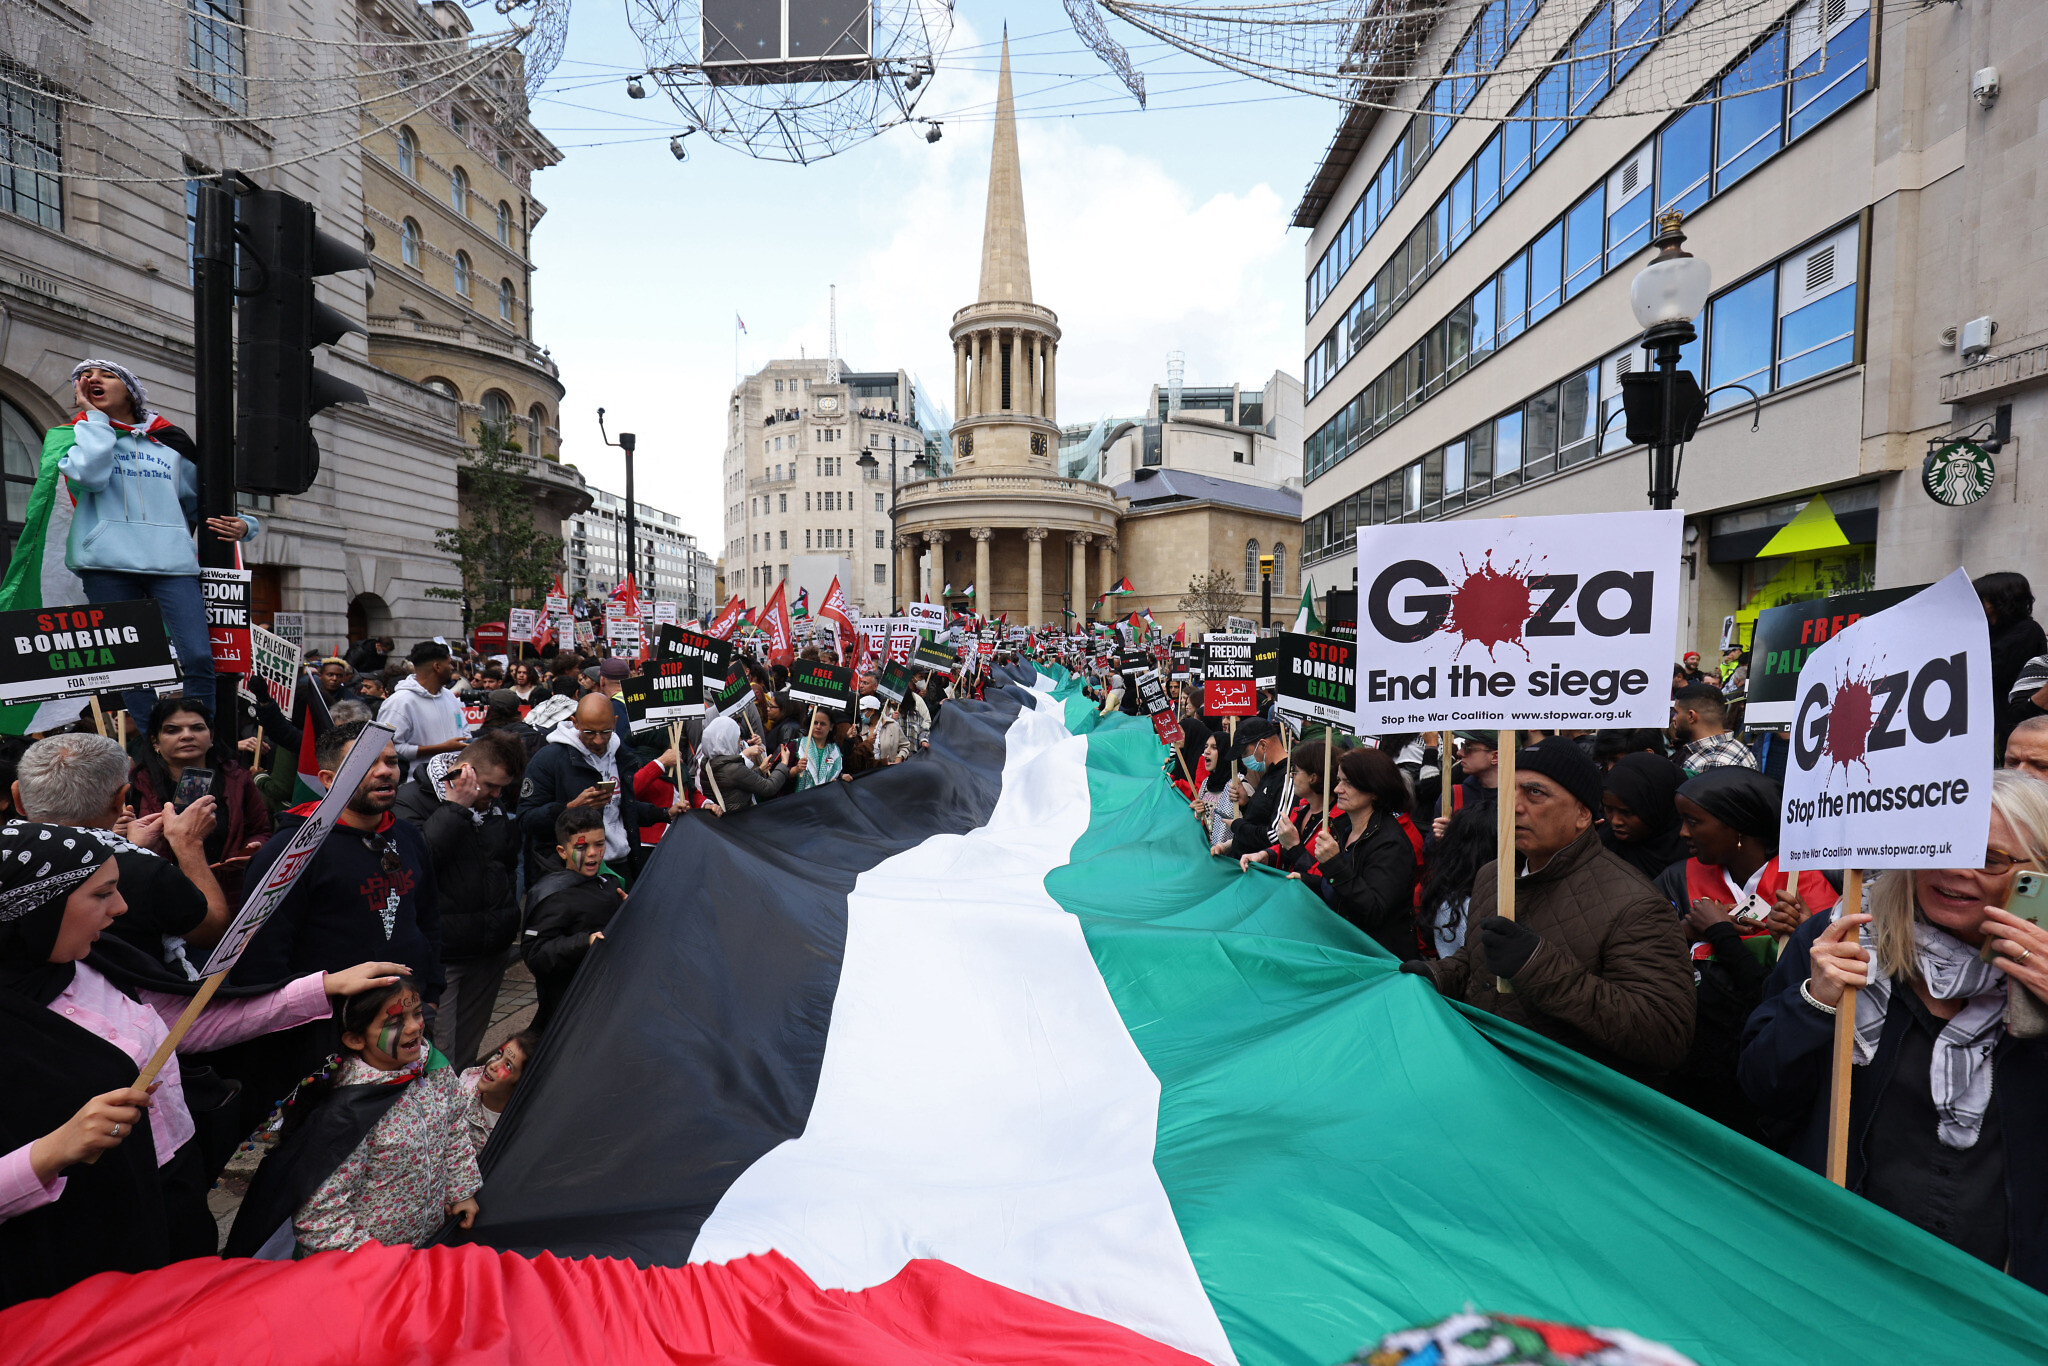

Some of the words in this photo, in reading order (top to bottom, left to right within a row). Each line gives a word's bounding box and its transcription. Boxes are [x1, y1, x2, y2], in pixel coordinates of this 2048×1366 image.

[202, 583, 244, 601] EDOM
[1368, 558, 1655, 644] Gza
[37, 610, 104, 632] STOP
[206, 608, 247, 626] STINE
[14, 625, 140, 655] BOMBING
[1331, 626, 1357, 635] BOMBIN
[263, 635, 297, 663] PALESTINE
[681, 632, 710, 649] STOP
[49, 648, 116, 671] GAZA
[668, 640, 719, 664] BOMBING
[1209, 645, 1251, 659] FREEDOM
[1308, 641, 1348, 664] STOP
[255, 646, 295, 678] XIST!
[660, 662, 683, 676] STOP
[1207, 665, 1254, 678] PALESTINE
[1292, 657, 1354, 686] BOMBIN
[67, 677, 86, 688] FOA
[256, 662, 293, 689] ESIST!
[653, 674, 693, 690] BOMBING
[799, 674, 843, 691] PALESTINE
[812, 667, 833, 680] FREE
[718, 676, 747, 702] PALESTINE
[1215, 683, 1247, 697] الحرية
[1307, 679, 1347, 703] GAZA
[1368, 666, 1437, 703] End
[1448, 664, 1516, 699] the
[1527, 662, 1649, 706] siege
[662, 689, 684, 703] GAZA
[1314, 705, 1325, 716] FOA
[1381, 715, 1405, 725] Stop
[1408, 714, 1425, 723] the
[1428, 713, 1449, 722] War
[1451, 711, 1504, 721] Coalition
[1511, 709, 1632, 721] www.stopwar.org.uk
[1794, 650, 1968, 772] Gza
[1786, 798, 1815, 827] Stop
[1817, 791, 1843, 819] the
[1846, 778, 1969, 815] massacre
[1790, 850, 1801, 861] Stop
[1802, 849, 1810, 859] the
[1810, 848, 1821, 859] War
[1822, 846, 1852, 857] Coalition
[1856, 842, 1953, 859] www.stopwar.org.uk
